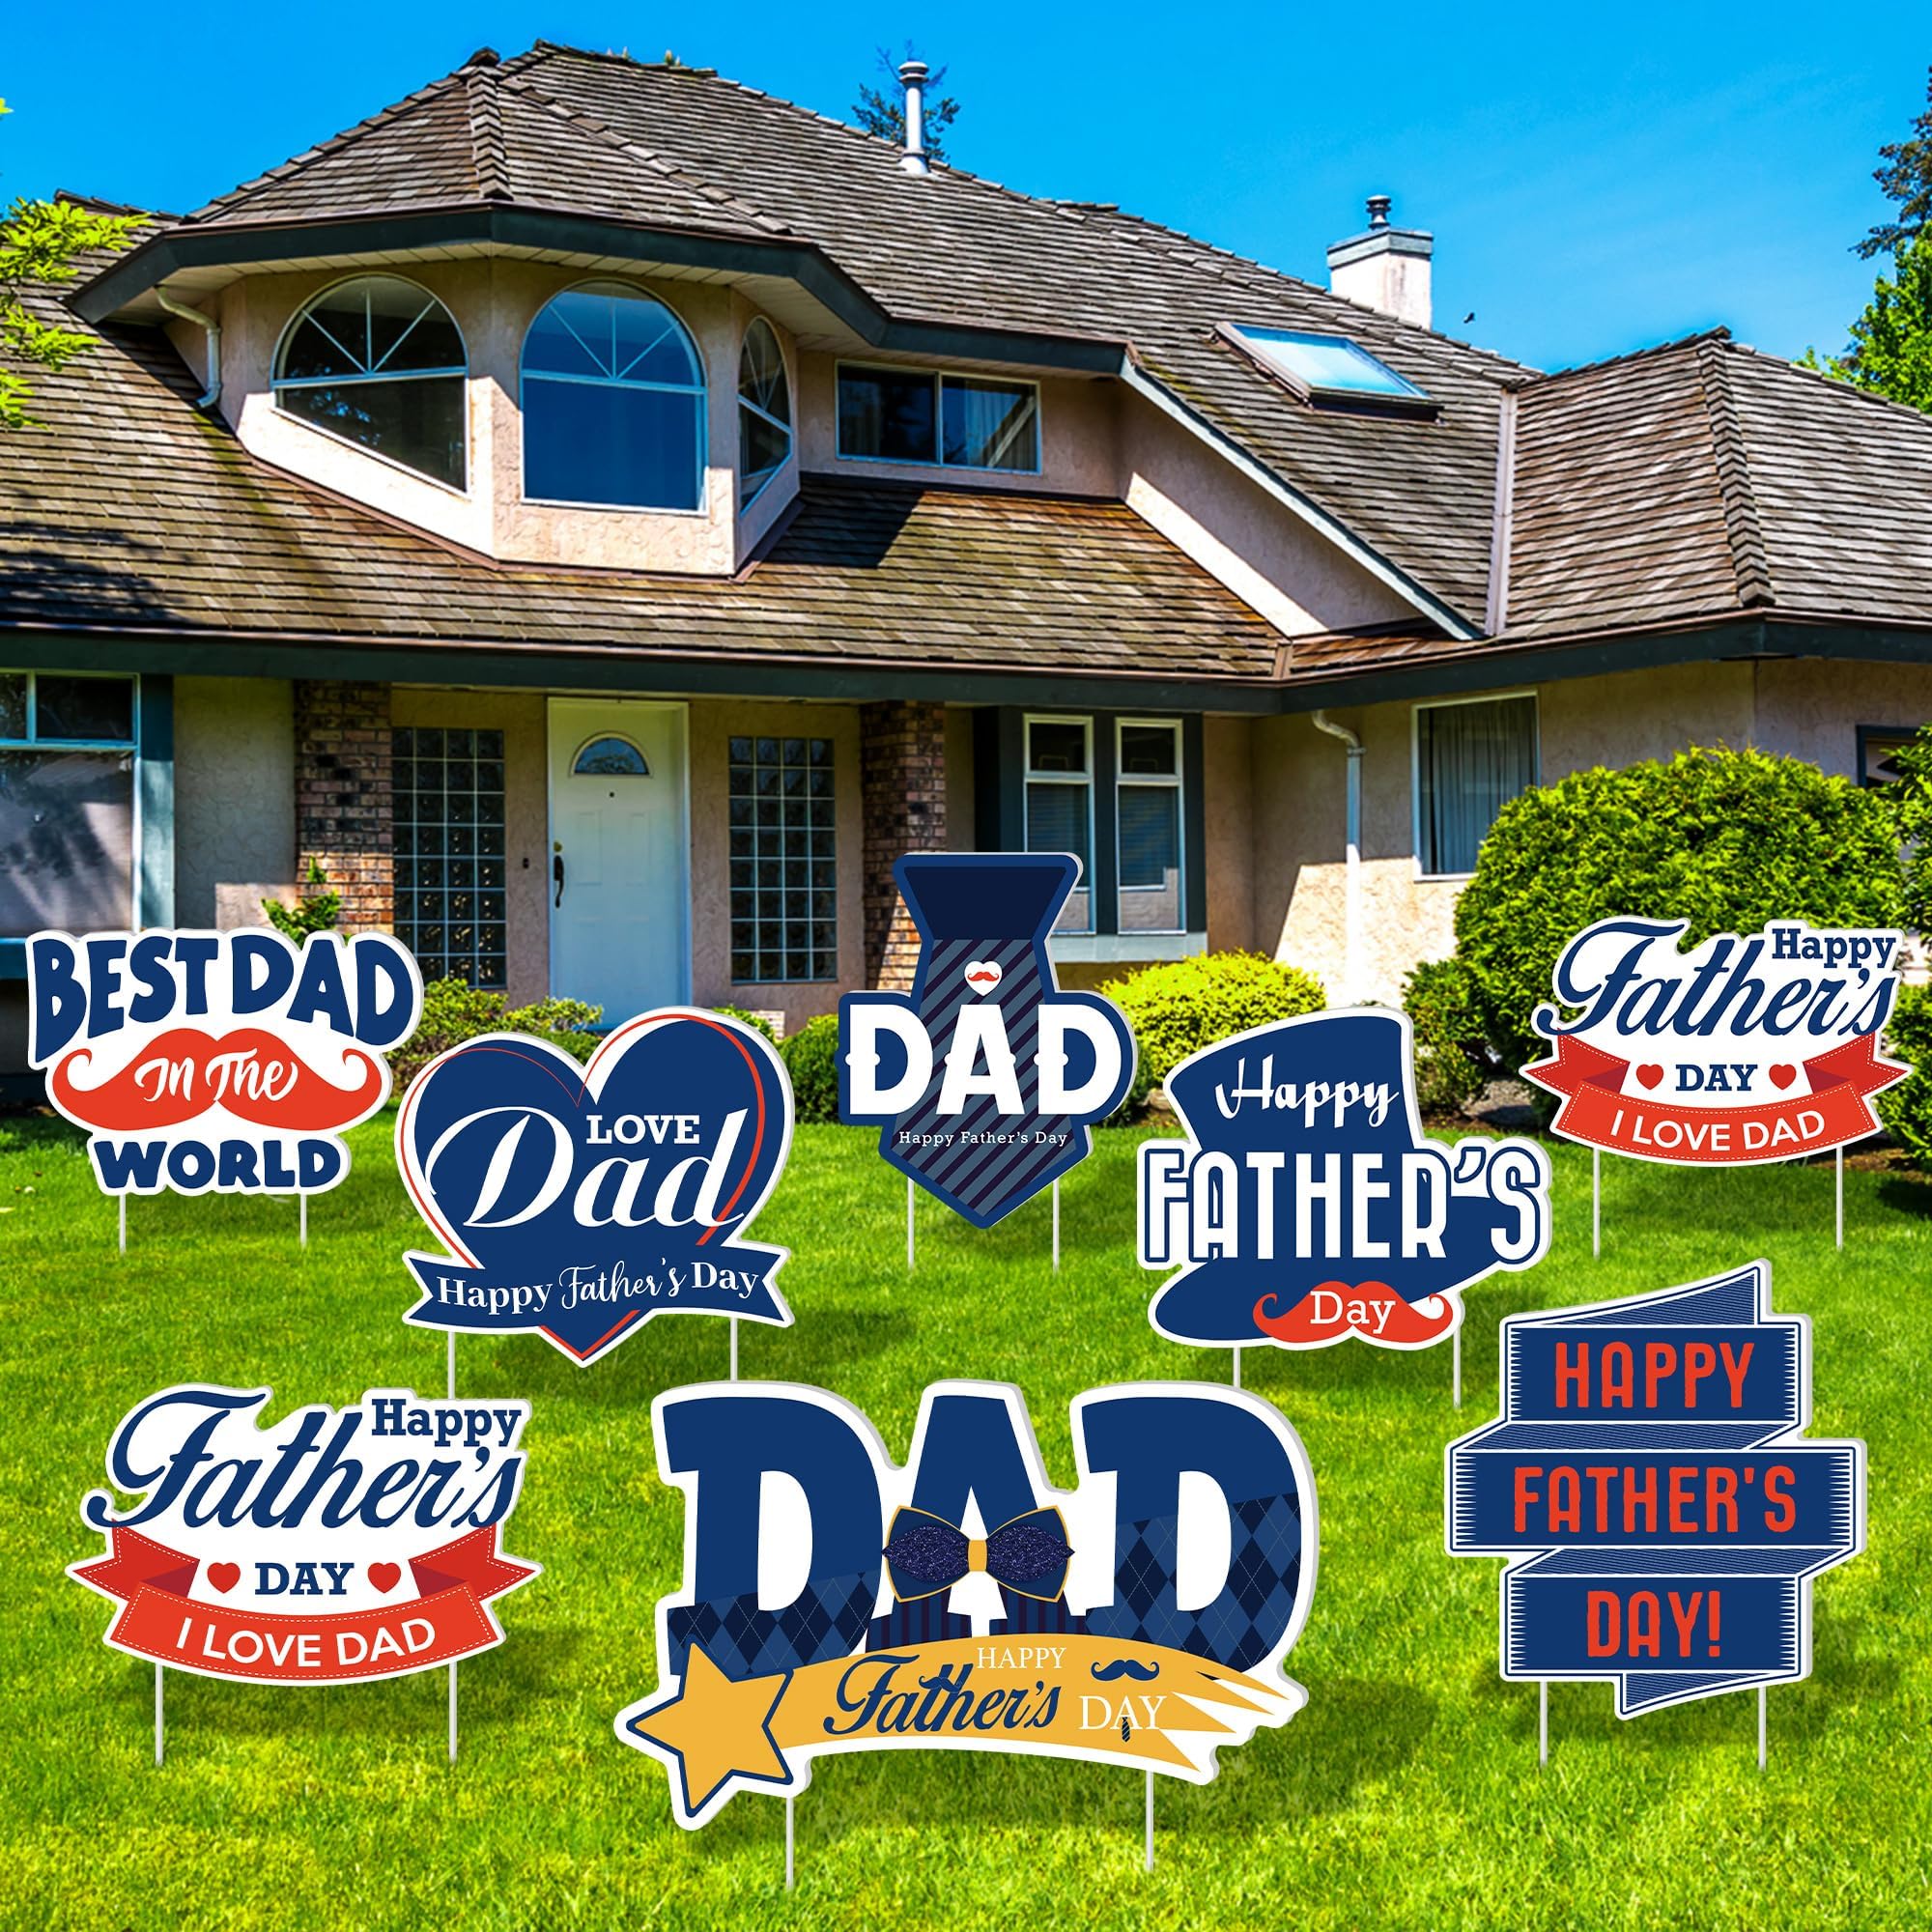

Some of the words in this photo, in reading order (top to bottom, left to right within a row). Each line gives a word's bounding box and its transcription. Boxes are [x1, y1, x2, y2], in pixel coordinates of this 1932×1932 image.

[1772, 927, 1896, 969] Happy
[32, 936, 219, 1063] BEST
[231, 934, 414, 1046] DAD
[1536, 921, 1896, 1037] Father's
[133, 1057, 194, 1102] In
[205, 1048, 298, 1102] The
[845, 1004, 1122, 1116] DAD
[1675, 1064, 1758, 1092] DAY
[1214, 1053, 1400, 1129] Happy
[585, 1114, 700, 1145] LOVE
[898, 1131, 954, 1148] Happy
[960, 1131, 1029, 1145] Father's
[1035, 1131, 1068, 1148] Day
[1610, 1109, 1625, 1137] I
[1632, 1118, 1731, 1151] LOVE
[1742, 1110, 1826, 1151] DAD
[94, 1138, 342, 1189] WORLD
[425, 1106, 750, 1228] Dad
[1146, 1147, 1540, 1263] FATHER'S
[436, 1275, 553, 1317] Happy
[557, 1257, 687, 1310] Father's
[690, 1262, 759, 1299] Day
[1309, 1290, 1397, 1334] Day
[1554, 1341, 1755, 1408] HAPPY
[371, 1398, 523, 1448] Happy
[86, 1389, 523, 1529] Father's
[1514, 1465, 1796, 1534] FATHER'S
[662, 1393, 1302, 1683] DAD
[254, 1561, 355, 1596] DAY
[175, 1616, 194, 1650] I
[202, 1629, 322, 1668] LOVE
[336, 1617, 437, 1666] DAD
[1586, 1589, 1721, 1659] DAY!
[976, 1646, 1067, 1670] HAPPY
[823, 1654, 1063, 1735] Father's
[1078, 1694, 1168, 1731] DAY
